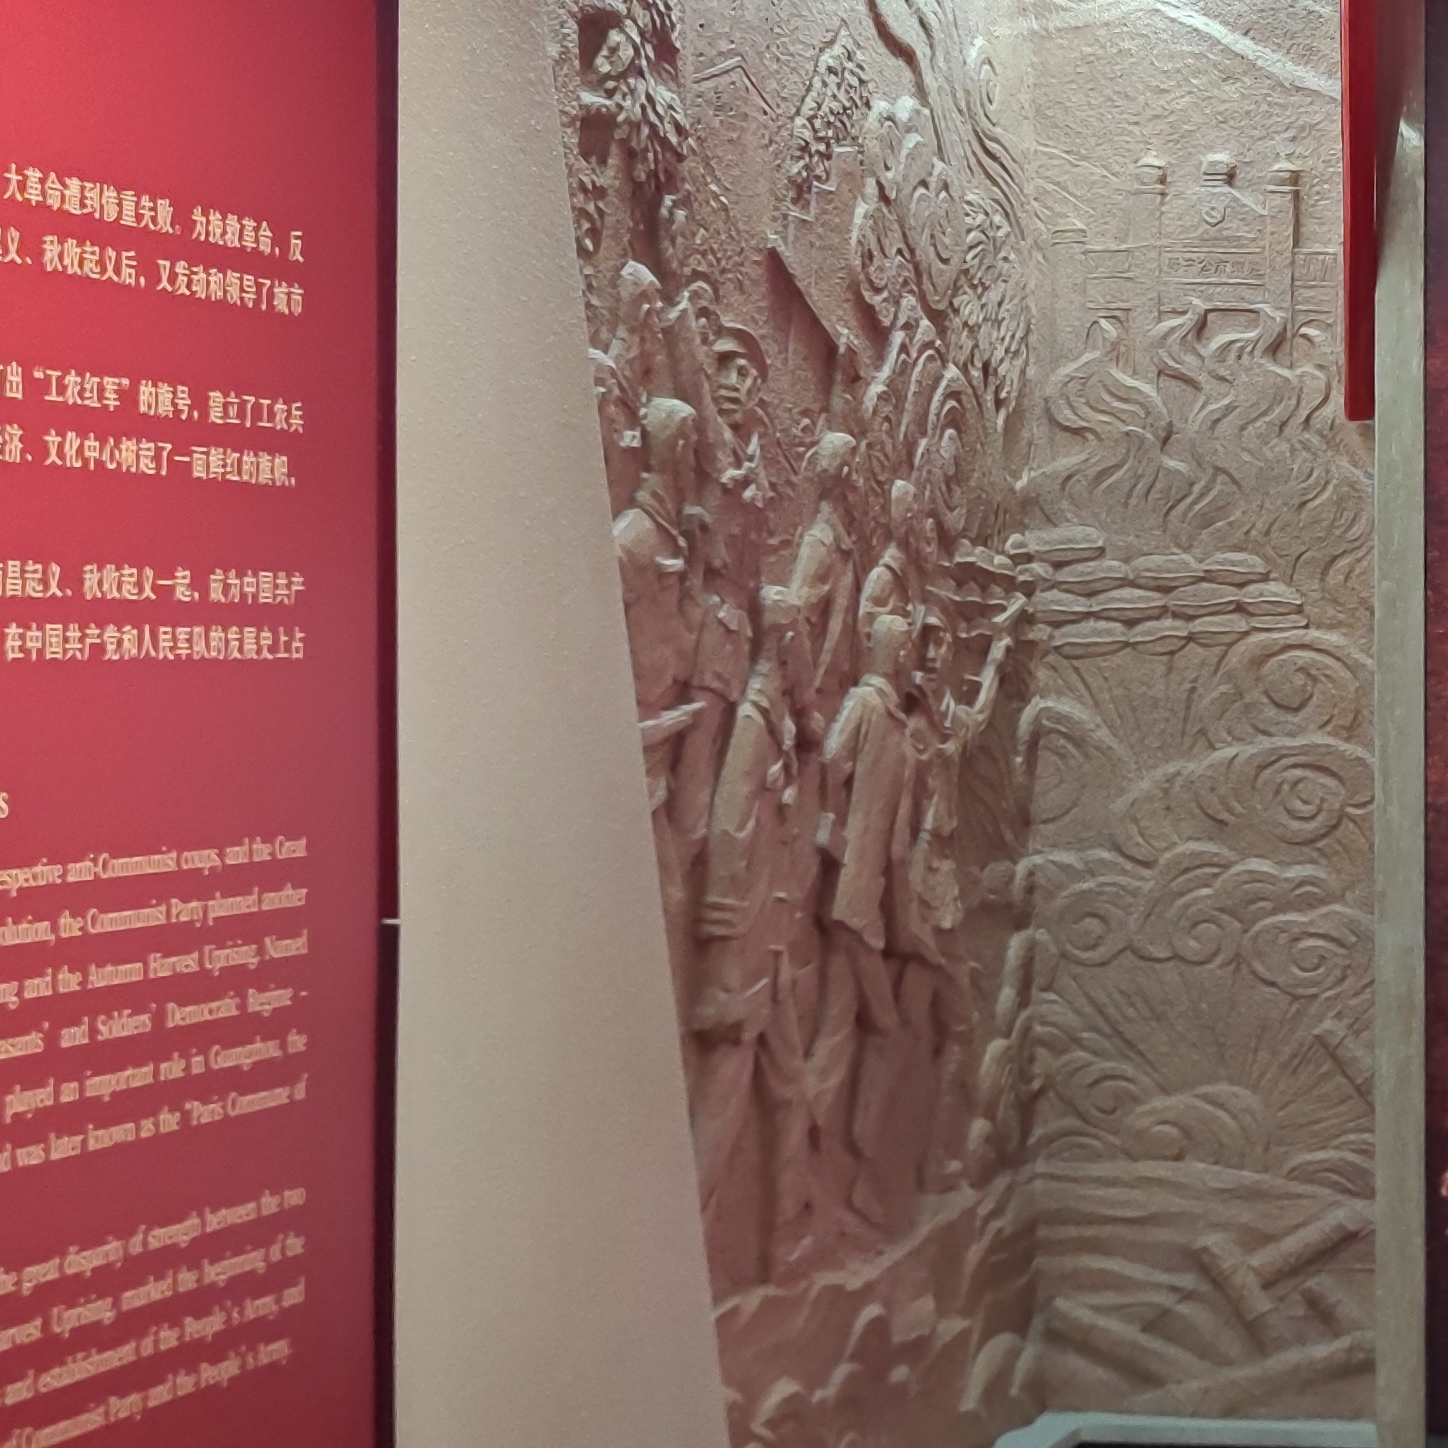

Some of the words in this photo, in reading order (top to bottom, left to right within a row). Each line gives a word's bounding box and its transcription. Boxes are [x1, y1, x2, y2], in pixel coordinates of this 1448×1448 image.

[224, 837, 249, 864] and
[251, 836, 273, 861] the
[274, 835, 306, 859] Great
